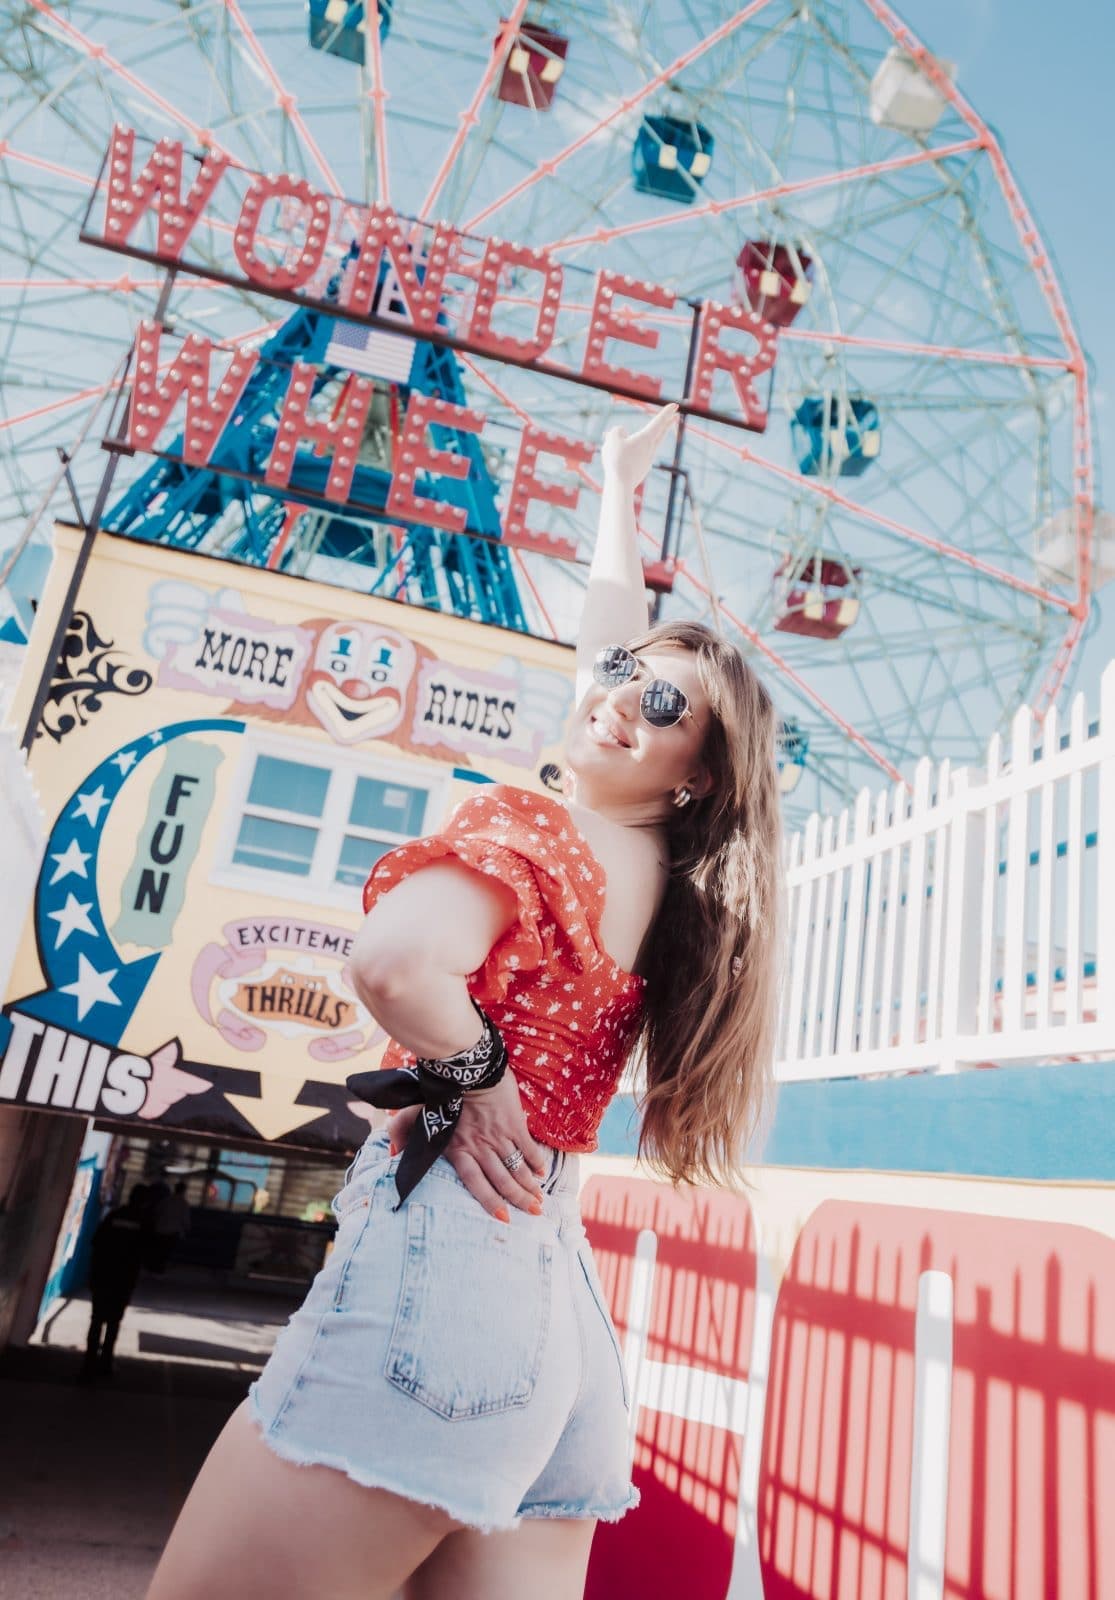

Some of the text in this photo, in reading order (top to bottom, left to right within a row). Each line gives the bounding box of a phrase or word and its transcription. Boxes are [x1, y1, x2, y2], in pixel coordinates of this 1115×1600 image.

[104, 123, 780, 427] WONDER
[195, 628, 515, 739] MORE RIDES
[133, 774, 199, 914] FUN
[237, 925, 354, 957] EXCITEME
[243, 985, 349, 1028] THRILLS
[0, 1011, 153, 1115] THIS
